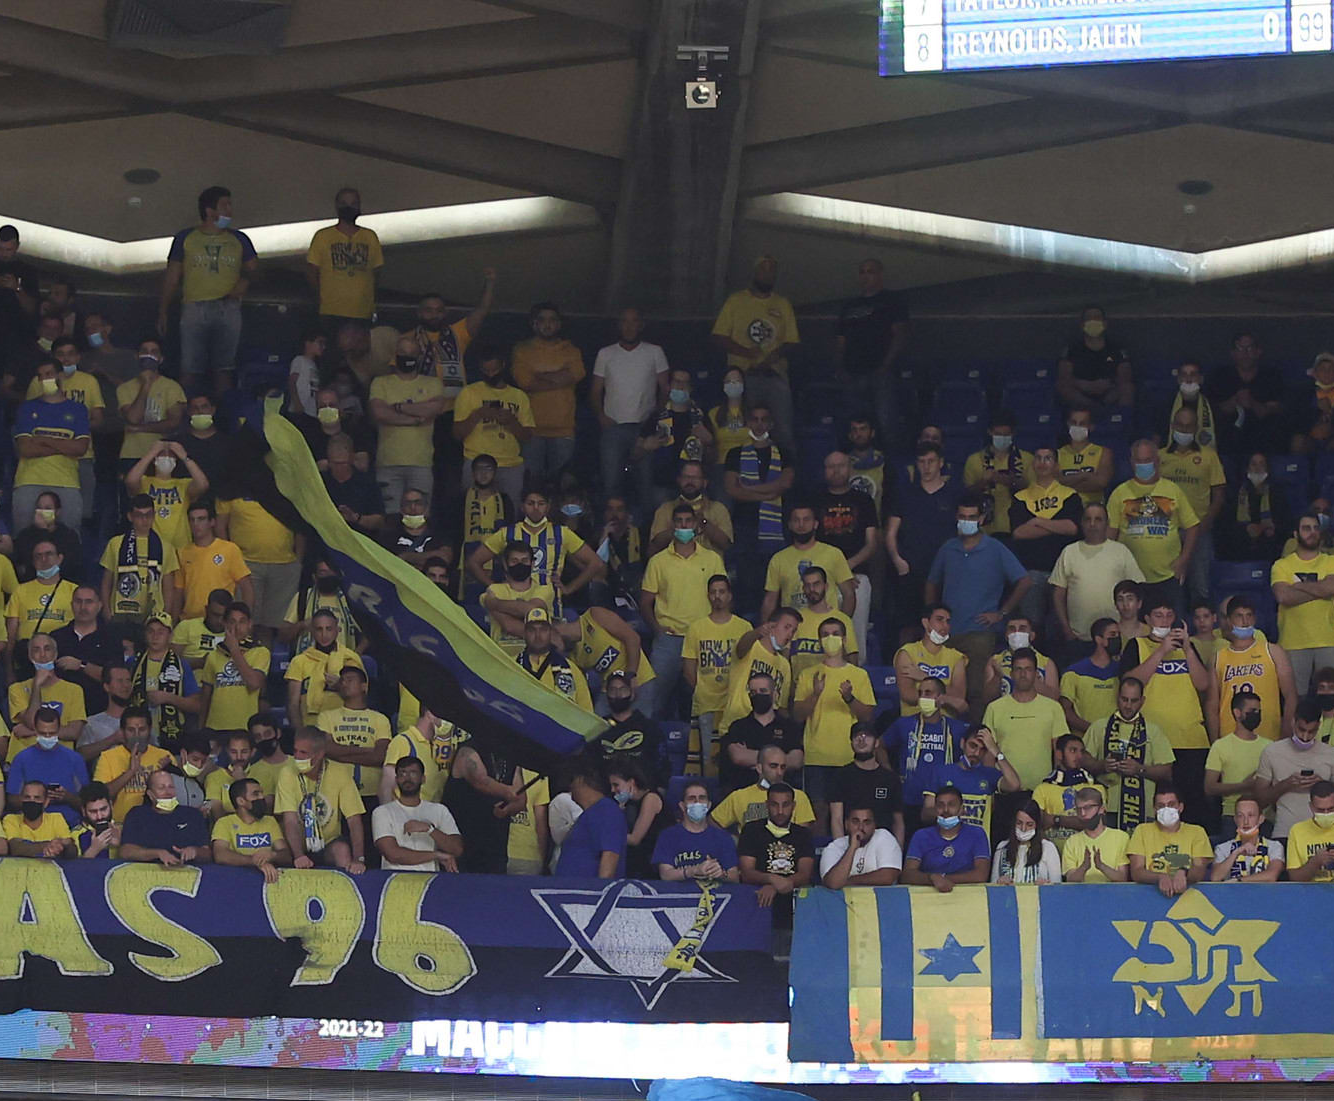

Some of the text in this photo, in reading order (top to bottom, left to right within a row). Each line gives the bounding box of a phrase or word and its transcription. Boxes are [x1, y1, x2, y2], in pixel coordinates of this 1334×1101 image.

[952, 28, 1073, 57] REYNOLDS,
[1077, 24, 1142, 51] JALEN
[1298, 13, 1324, 42] 99
[595, 646, 617, 672] FOX
[1225, 664, 1264, 681] LAKERS
[240, 835, 269, 846] FOX
[267, 869, 478, 995] 96
